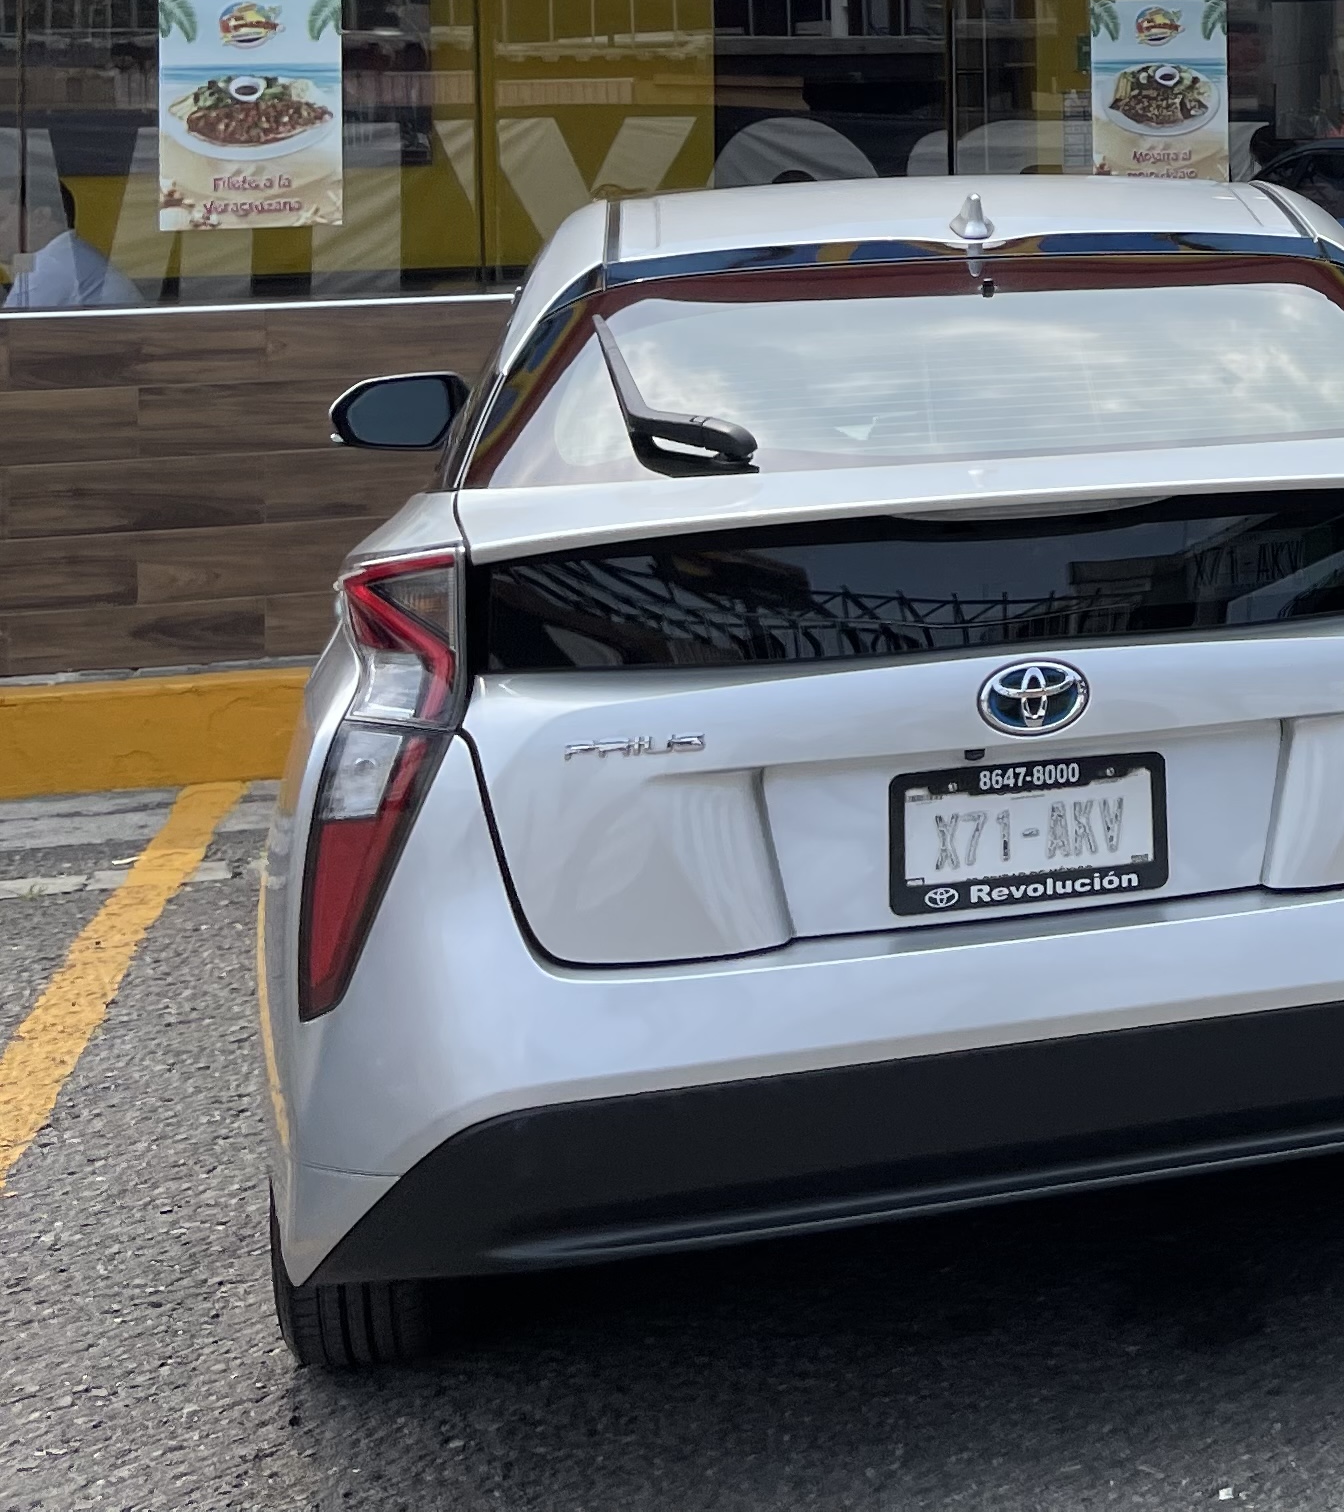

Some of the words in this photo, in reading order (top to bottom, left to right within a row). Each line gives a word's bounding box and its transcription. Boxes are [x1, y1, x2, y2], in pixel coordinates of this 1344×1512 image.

[213, 176, 260, 191] Filete
[263, 178, 273, 189] a
[278, 174, 292, 189] la
[564, 732, 706, 761] PRIUS
[978, 763, 1081, 791] 8647-8000
[933, 796, 1124, 871] X71-AKV
[969, 871, 1139, 904] Revolución
